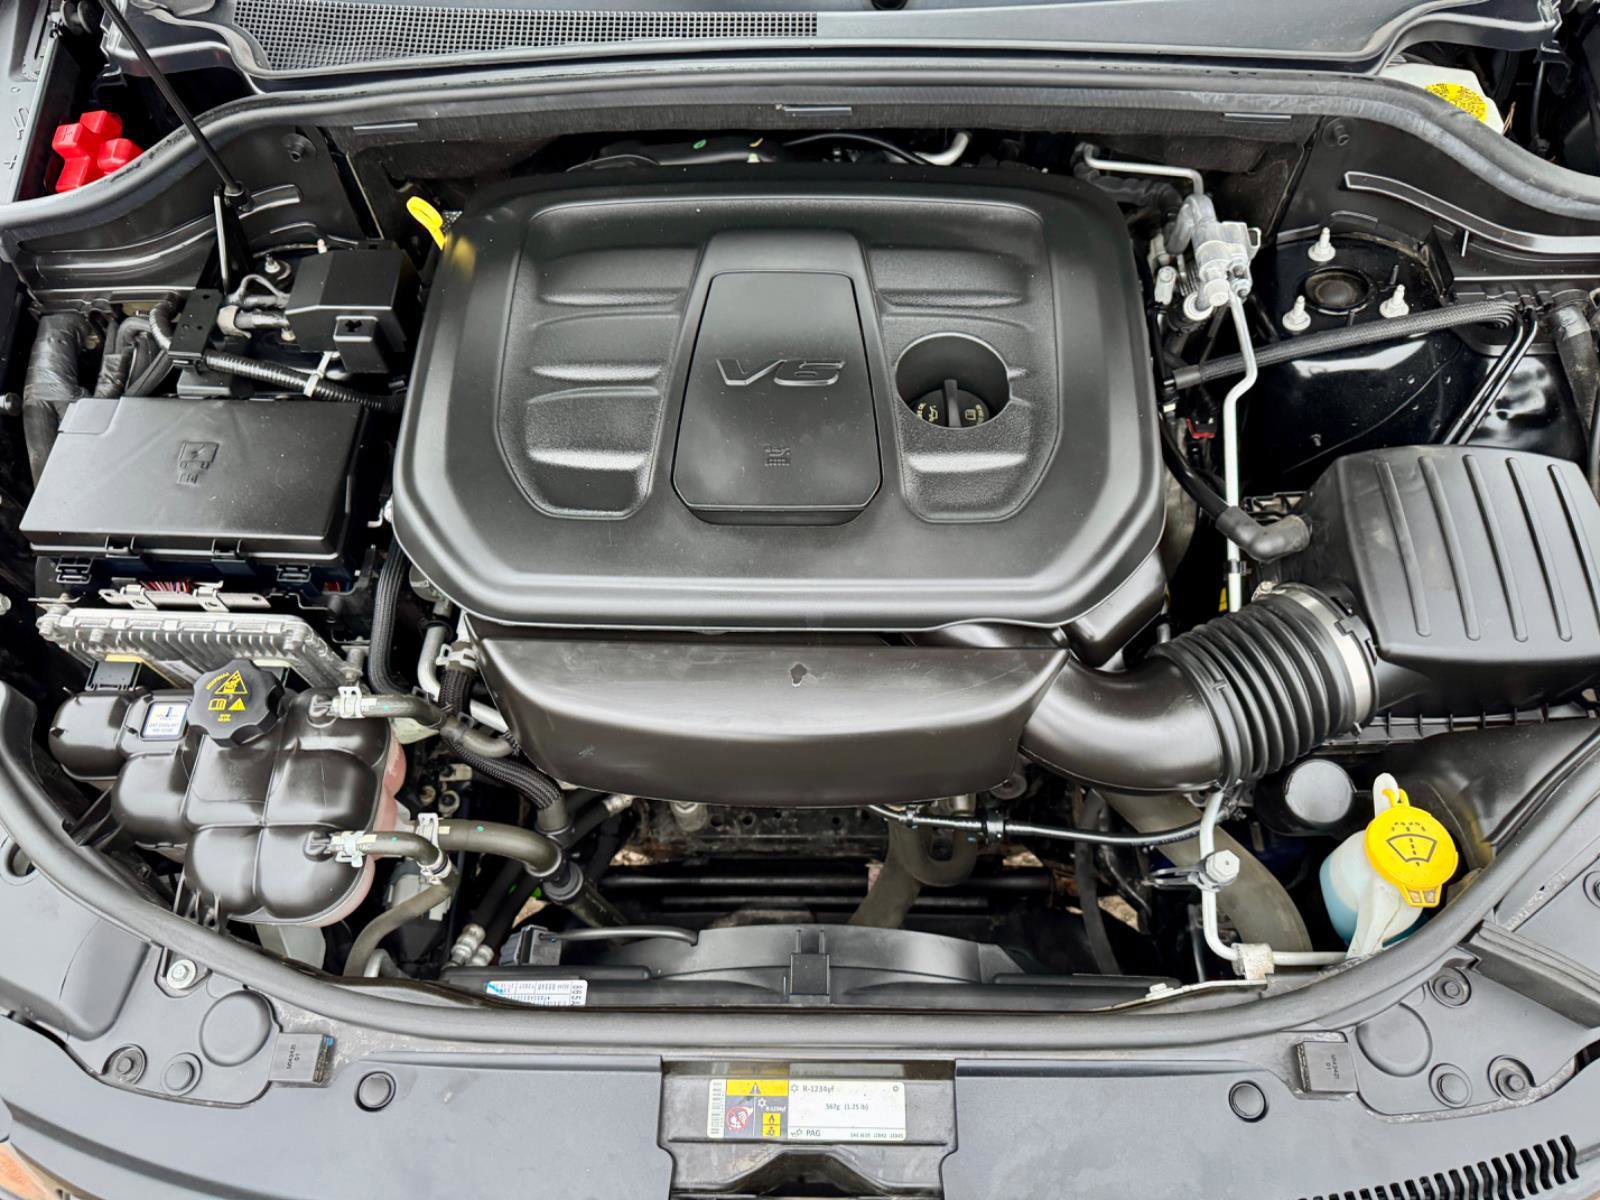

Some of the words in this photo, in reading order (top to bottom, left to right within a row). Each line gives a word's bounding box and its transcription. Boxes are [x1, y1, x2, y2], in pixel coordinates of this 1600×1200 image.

[715, 359, 846, 387] V6
[803, 1084, 835, 1094] R-1234yf
[806, 1129, 821, 1137] PAG
